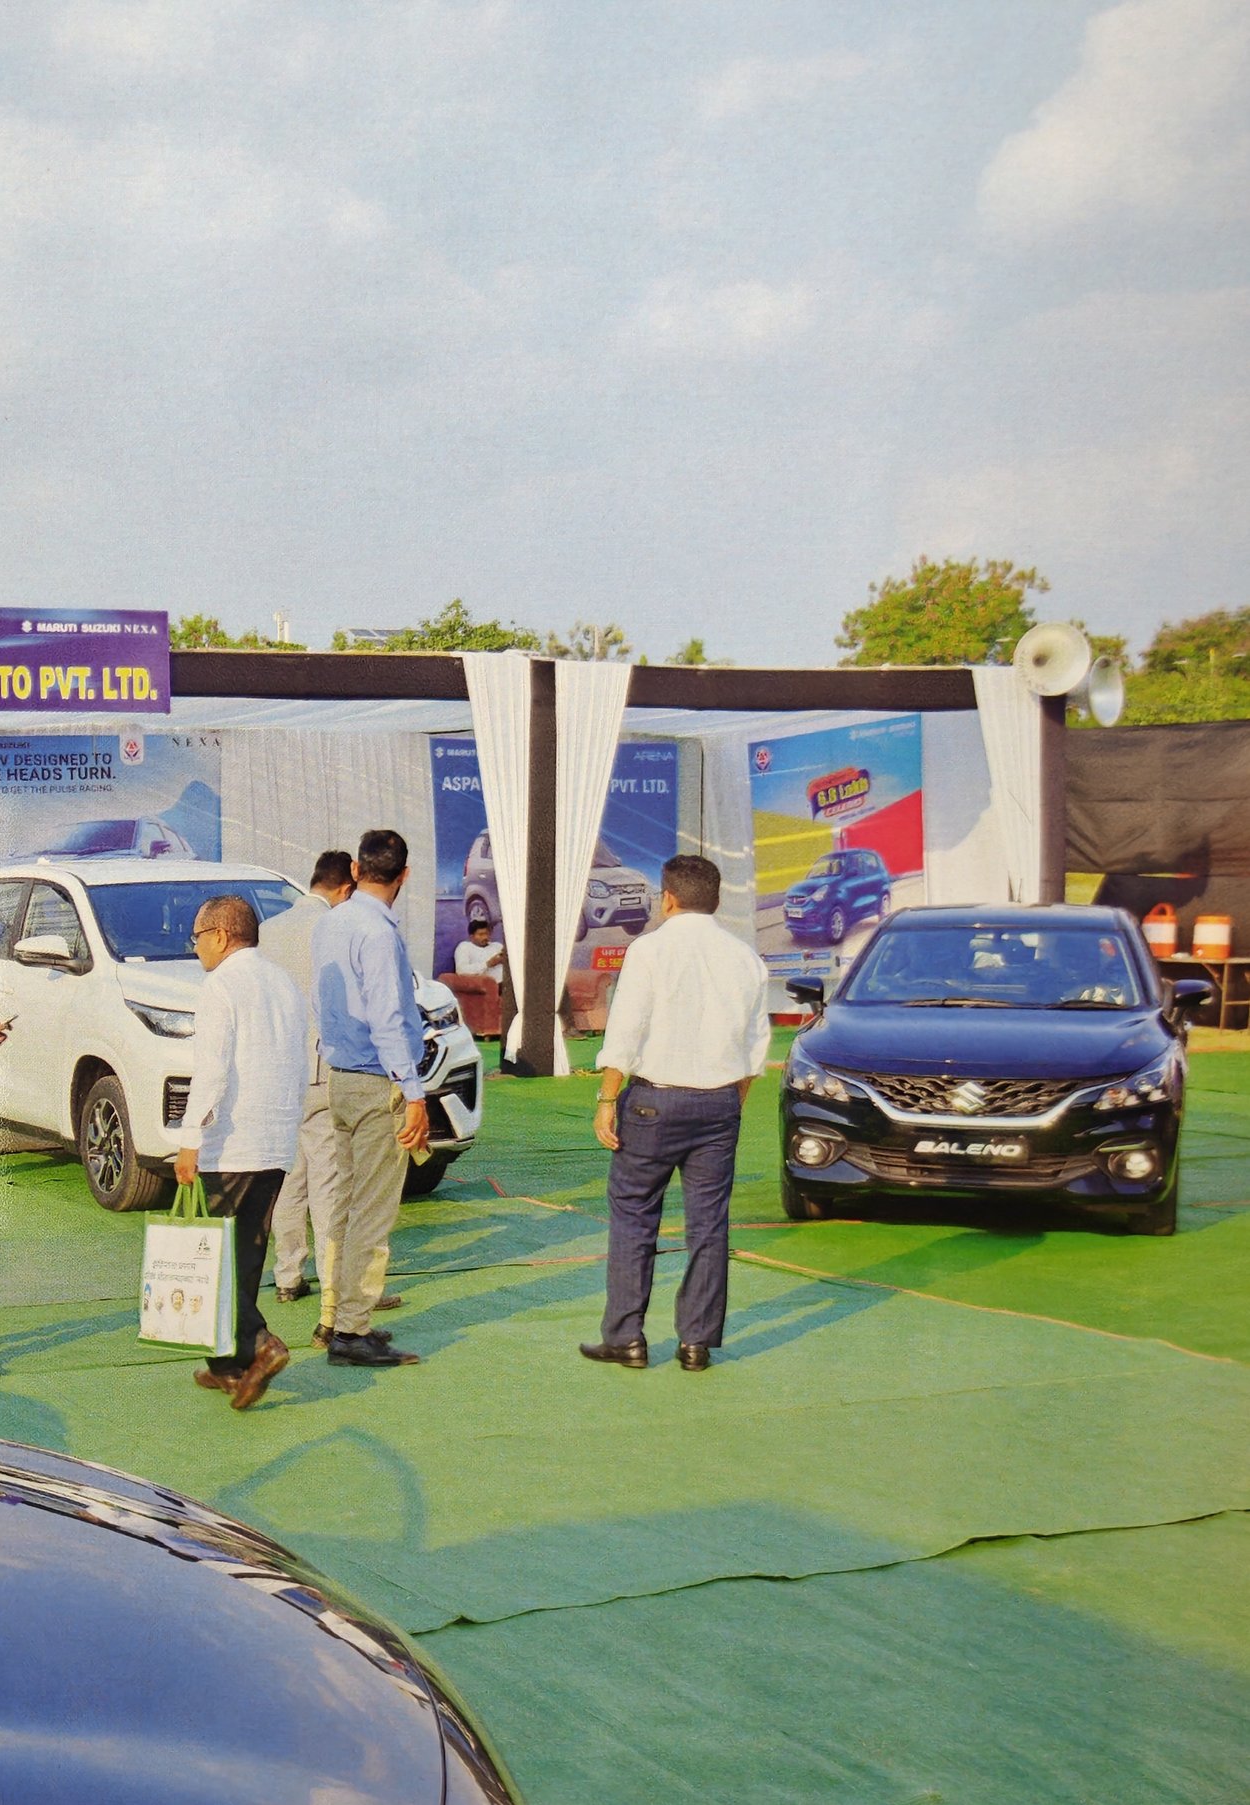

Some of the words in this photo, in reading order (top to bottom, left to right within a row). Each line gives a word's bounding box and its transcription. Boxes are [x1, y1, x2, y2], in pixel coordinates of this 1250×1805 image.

[36, 622, 78, 633] MARUTI
[80, 623, 121, 634] SUZUKI
[124, 624, 158, 634] NEXA
[39, 665, 96, 701] PVT.
[102, 666, 158, 701] LTD.
[171, 735, 222, 748] NEXA
[13, 753, 89, 767] DESIGNED
[91, 752, 113, 765] TO
[446, 748, 477, 757] MARUT
[6, 767, 63, 782] HEADS
[66, 766, 117, 780] TURN.
[30, 785, 48, 794] THE
[49, 784, 78, 794] PULSE
[442, 776, 481, 792] ASPA
[610, 778, 639, 793] PVT.
[642, 778, 670, 793] LTD.
[913, 1140, 1022, 1157] BALENO
